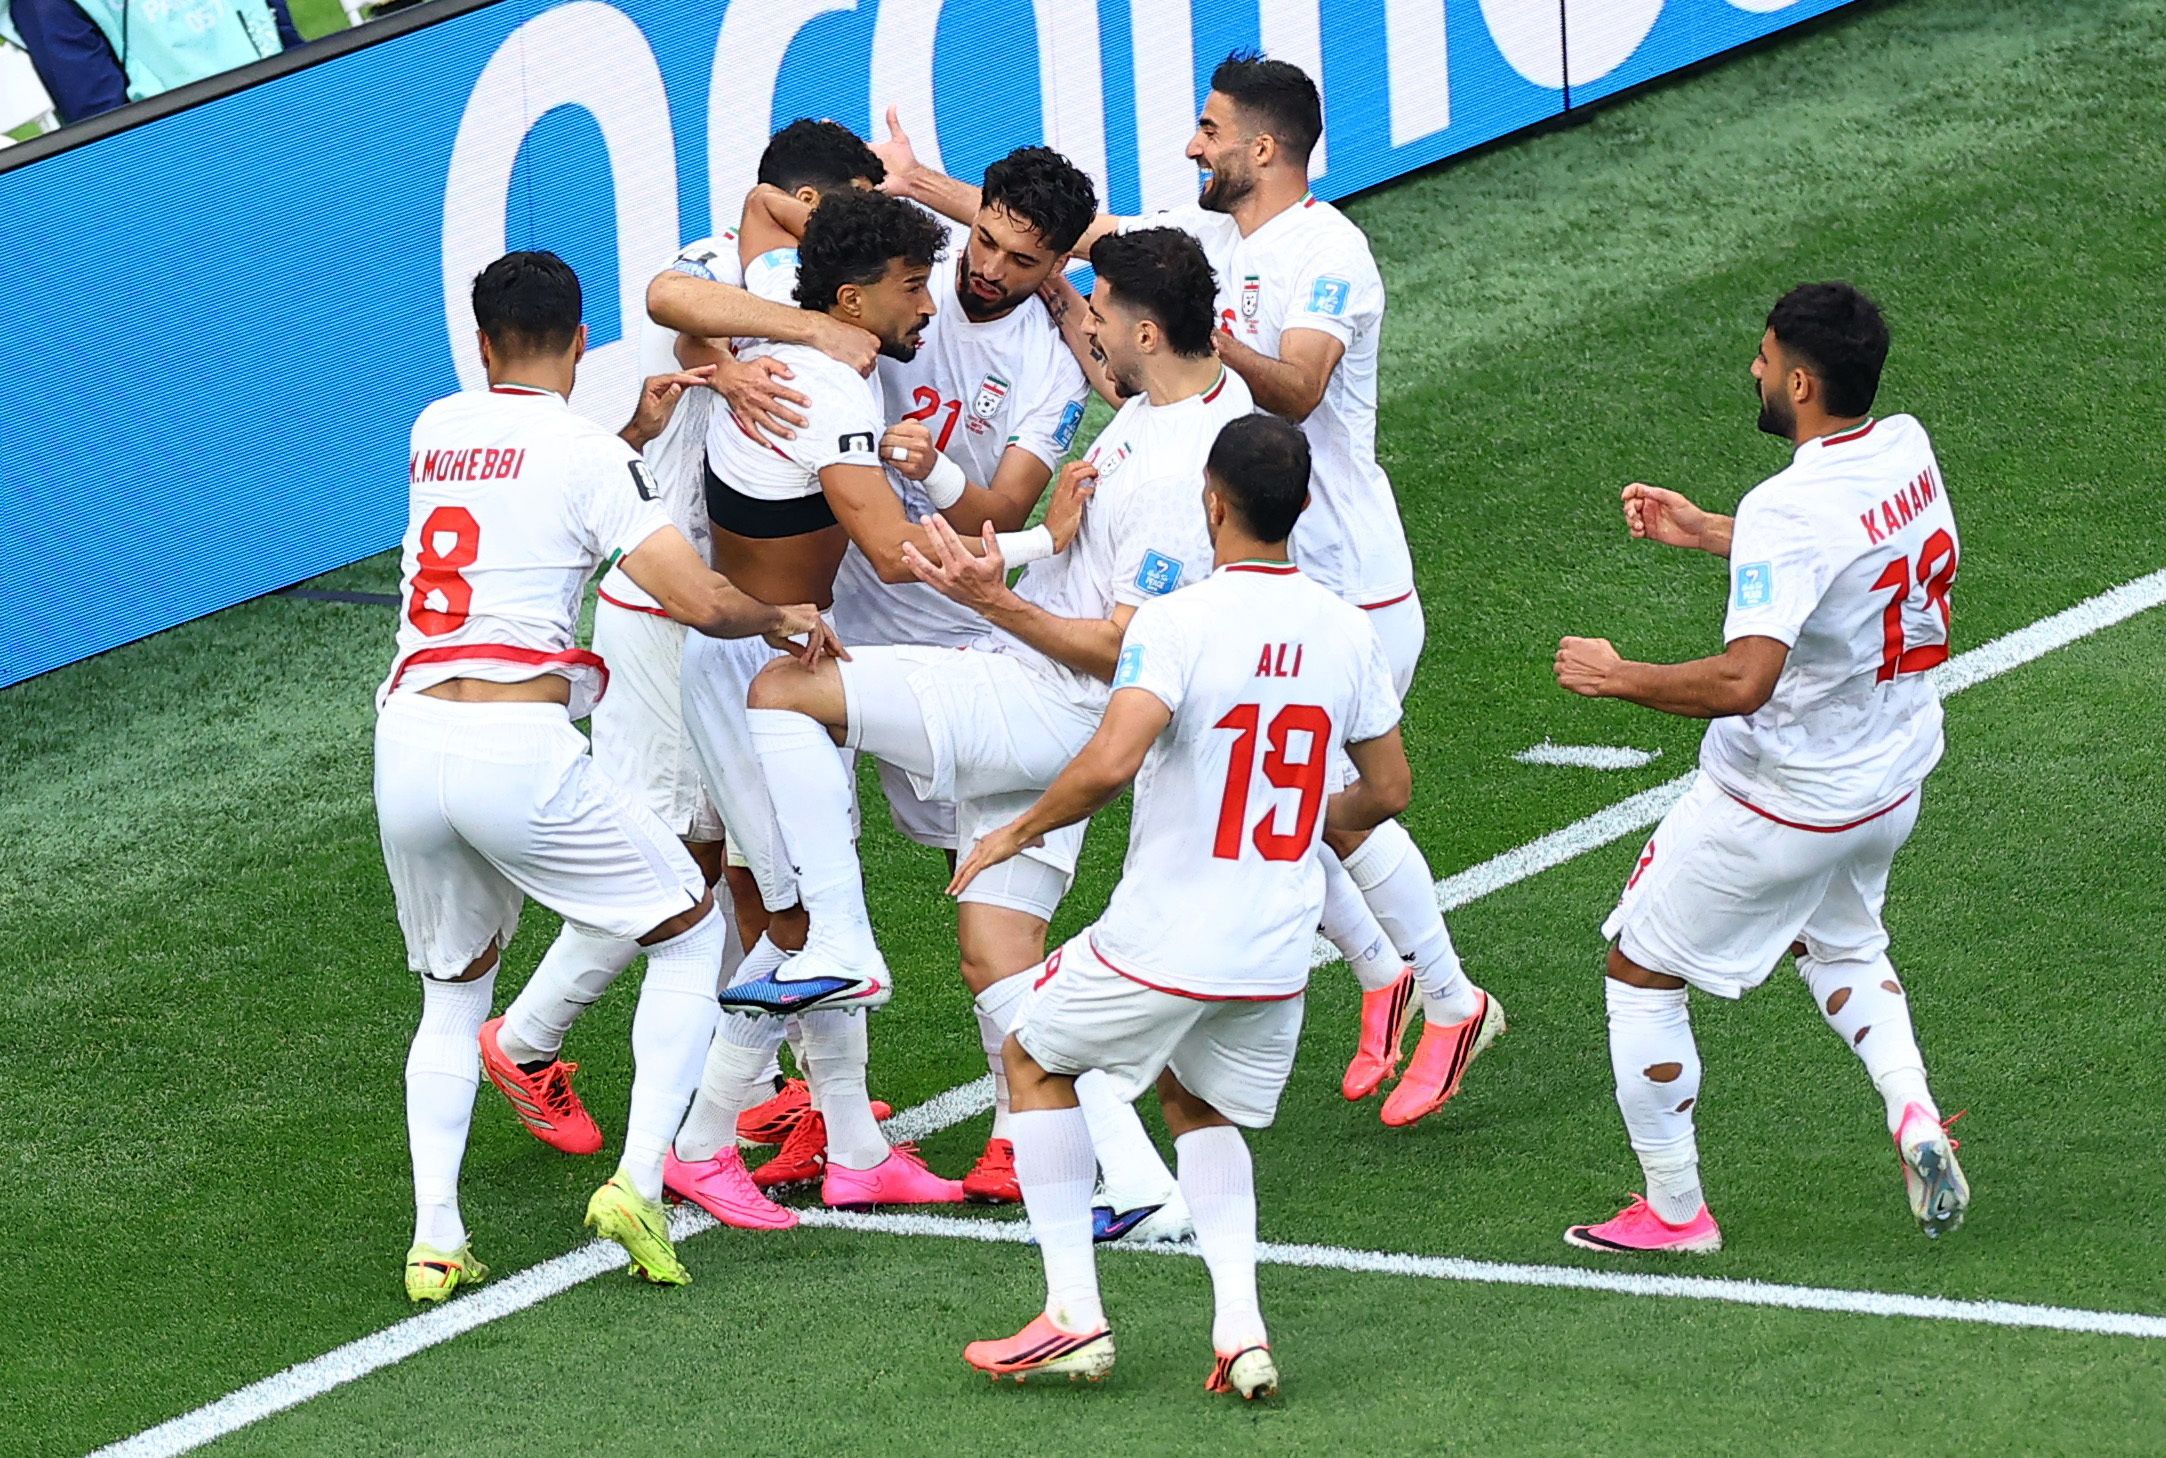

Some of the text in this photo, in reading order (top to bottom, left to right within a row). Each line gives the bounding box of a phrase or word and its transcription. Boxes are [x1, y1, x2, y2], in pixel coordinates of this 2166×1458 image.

[901, 385, 963, 453] 21
[1859, 464, 1938, 546] KANANI
[407, 505, 481, 637] 8
[1255, 643, 1303, 678] ALI
[1212, 703, 1332, 862] 19
